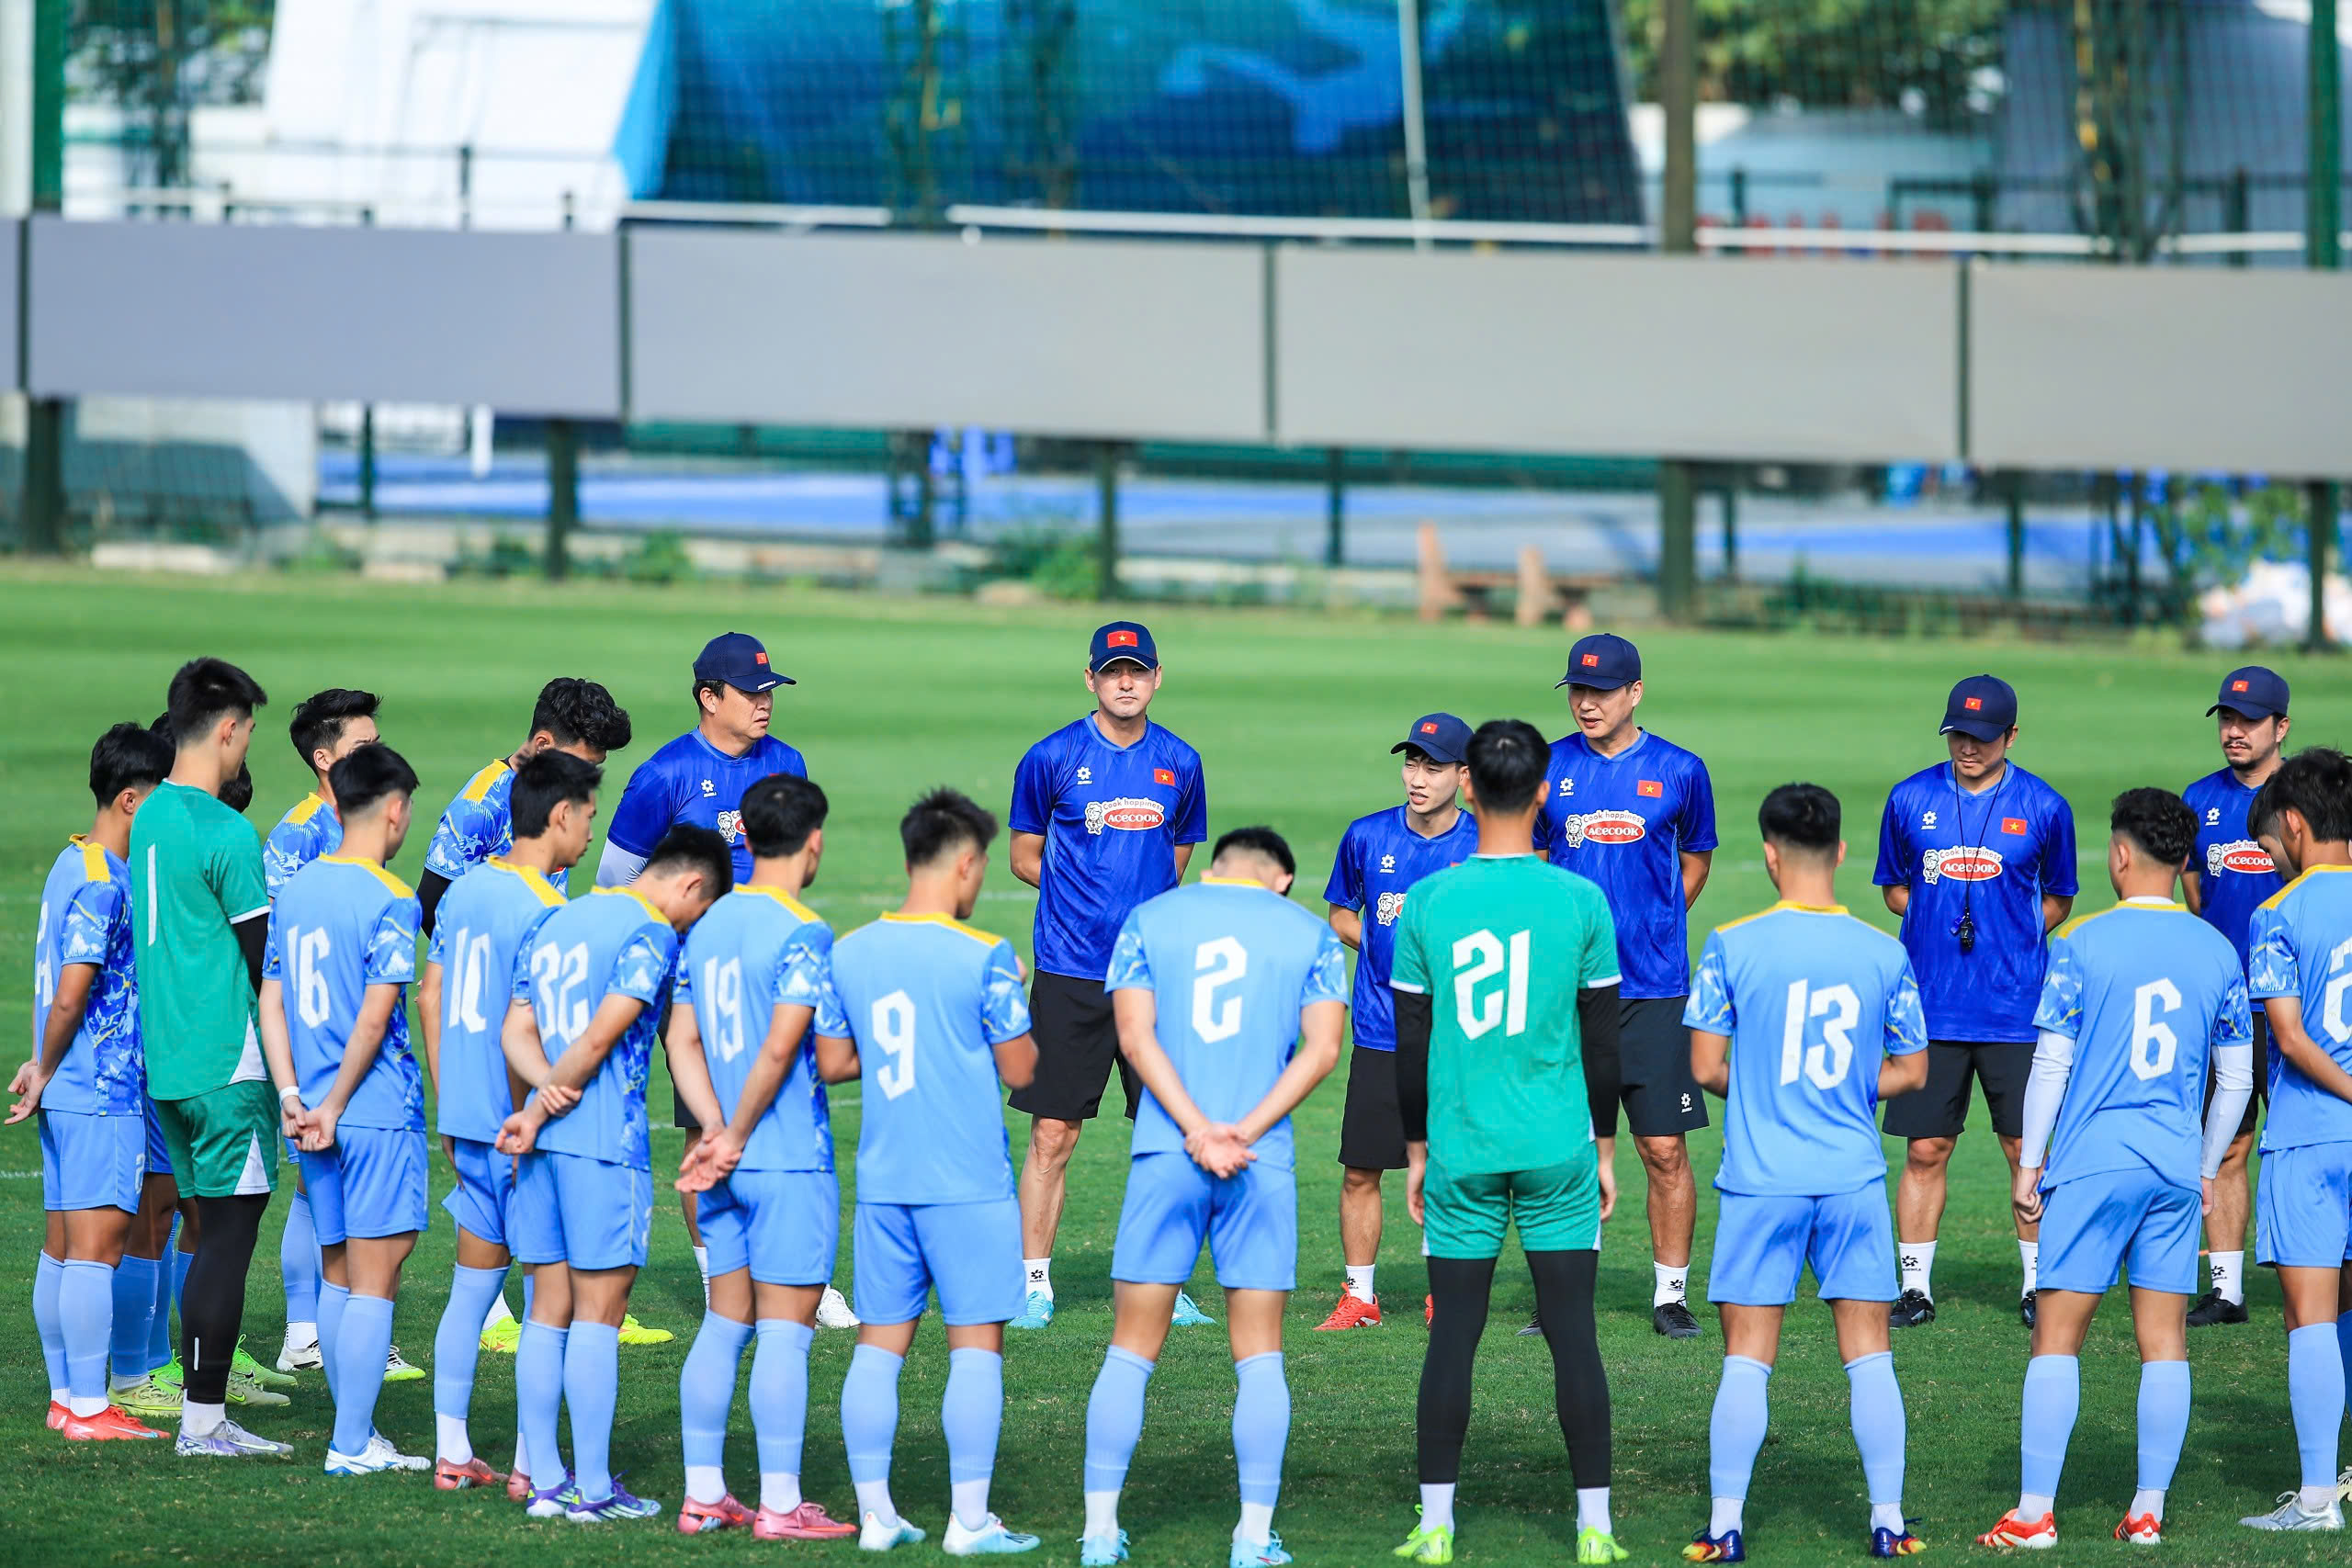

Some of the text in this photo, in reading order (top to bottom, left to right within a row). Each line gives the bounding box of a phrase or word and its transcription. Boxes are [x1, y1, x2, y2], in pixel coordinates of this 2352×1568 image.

[1103, 799, 1163, 811] Cook happiness
[1583, 811, 1645, 825] Cook happiness
[1939, 848, 1960, 859] Cook
[2223, 841, 2243, 852] Cook
[288, 925, 330, 1029] 16
[448, 927, 490, 1034] 10
[530, 942, 590, 1044] 32
[705, 956, 745, 1064] 19
[1193, 935, 1248, 1044] 2
[1452, 928, 1531, 1041] 21
[2130, 977, 2182, 1081] 6
[872, 988, 916, 1100] 9
[1780, 977, 1861, 1091] 13
